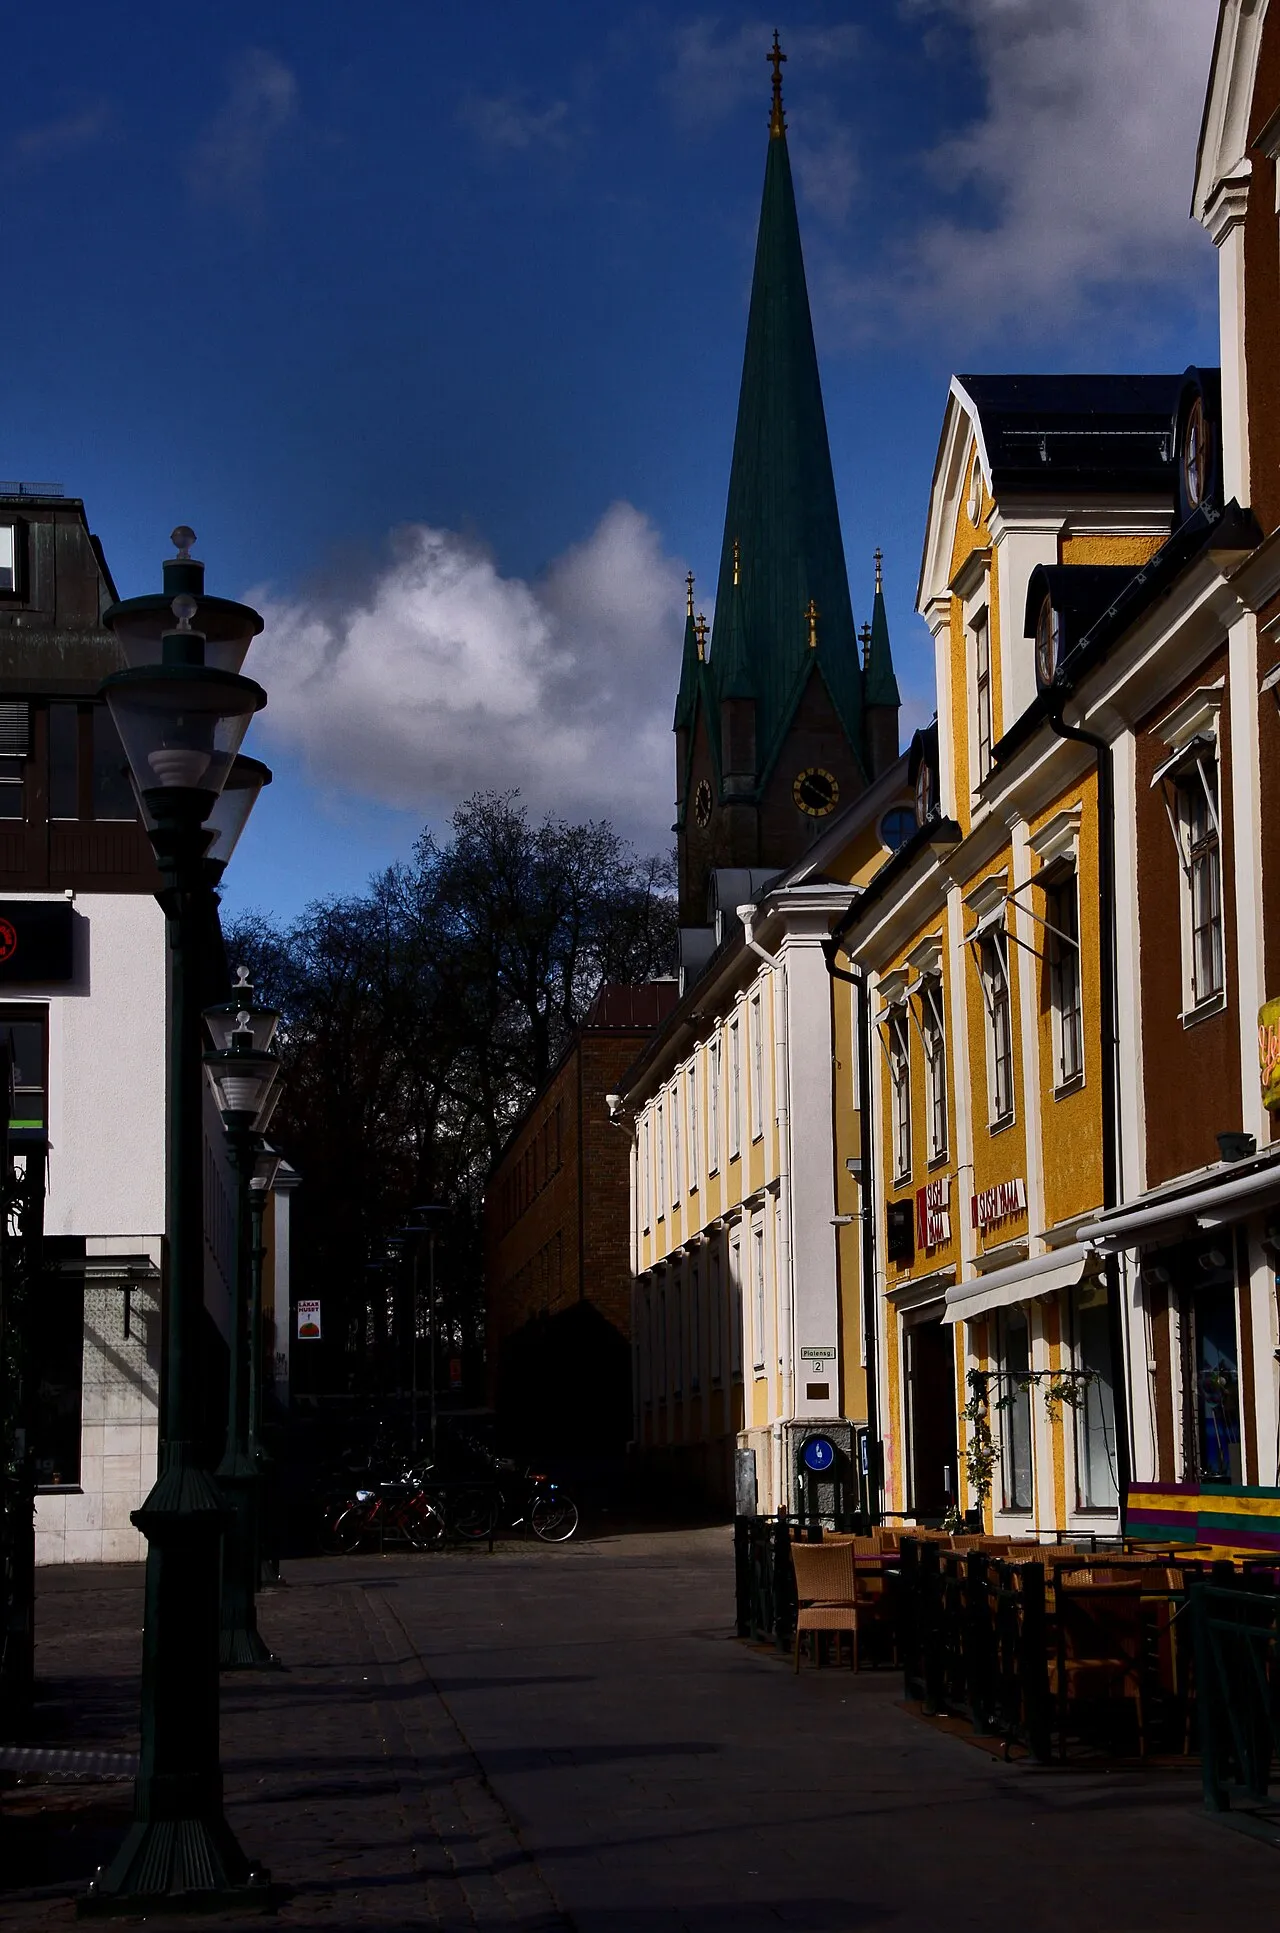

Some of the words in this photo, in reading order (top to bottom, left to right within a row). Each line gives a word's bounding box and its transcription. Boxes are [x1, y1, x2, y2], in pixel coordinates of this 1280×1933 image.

[998, 1178, 1026, 1216] YAMA
[927, 1211, 950, 1246] YAMA
[815, 1361, 821, 1371] 2
